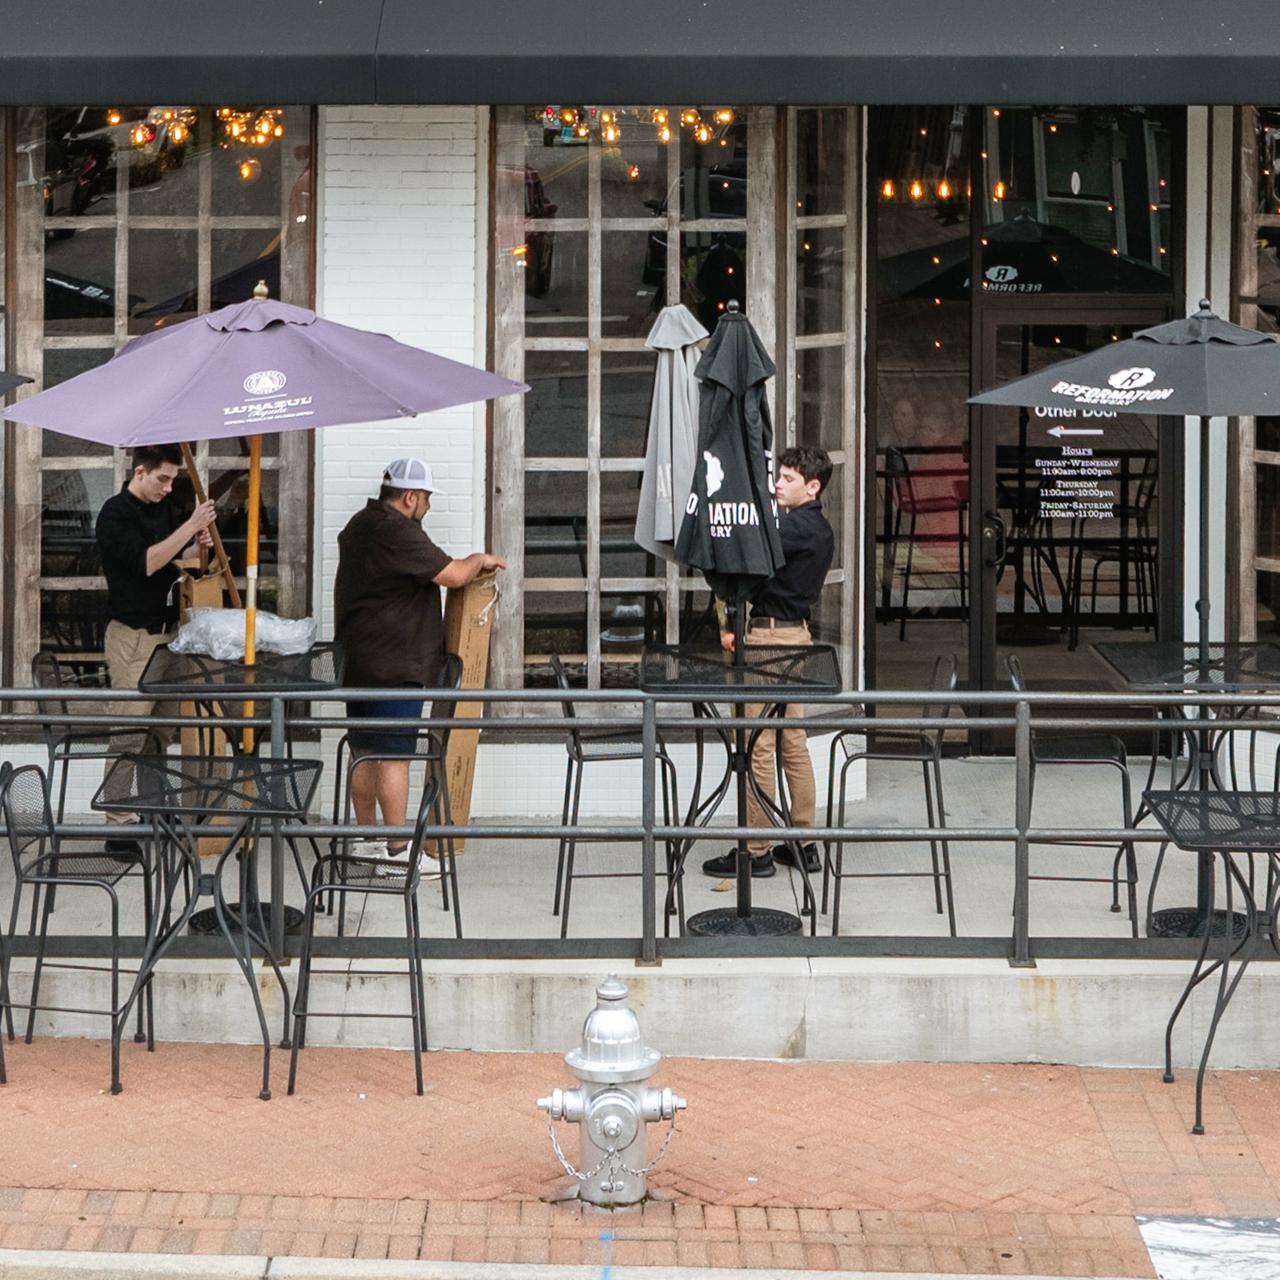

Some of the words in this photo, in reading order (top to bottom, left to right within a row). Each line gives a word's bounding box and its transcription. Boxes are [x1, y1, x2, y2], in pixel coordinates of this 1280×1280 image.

[1051, 381, 1174, 401] REFORMATION
[222, 396, 312, 415] LUNAZUL
[1061, 446, 1093, 456] Hours
[1056, 480, 1099, 488] THURSDAY
